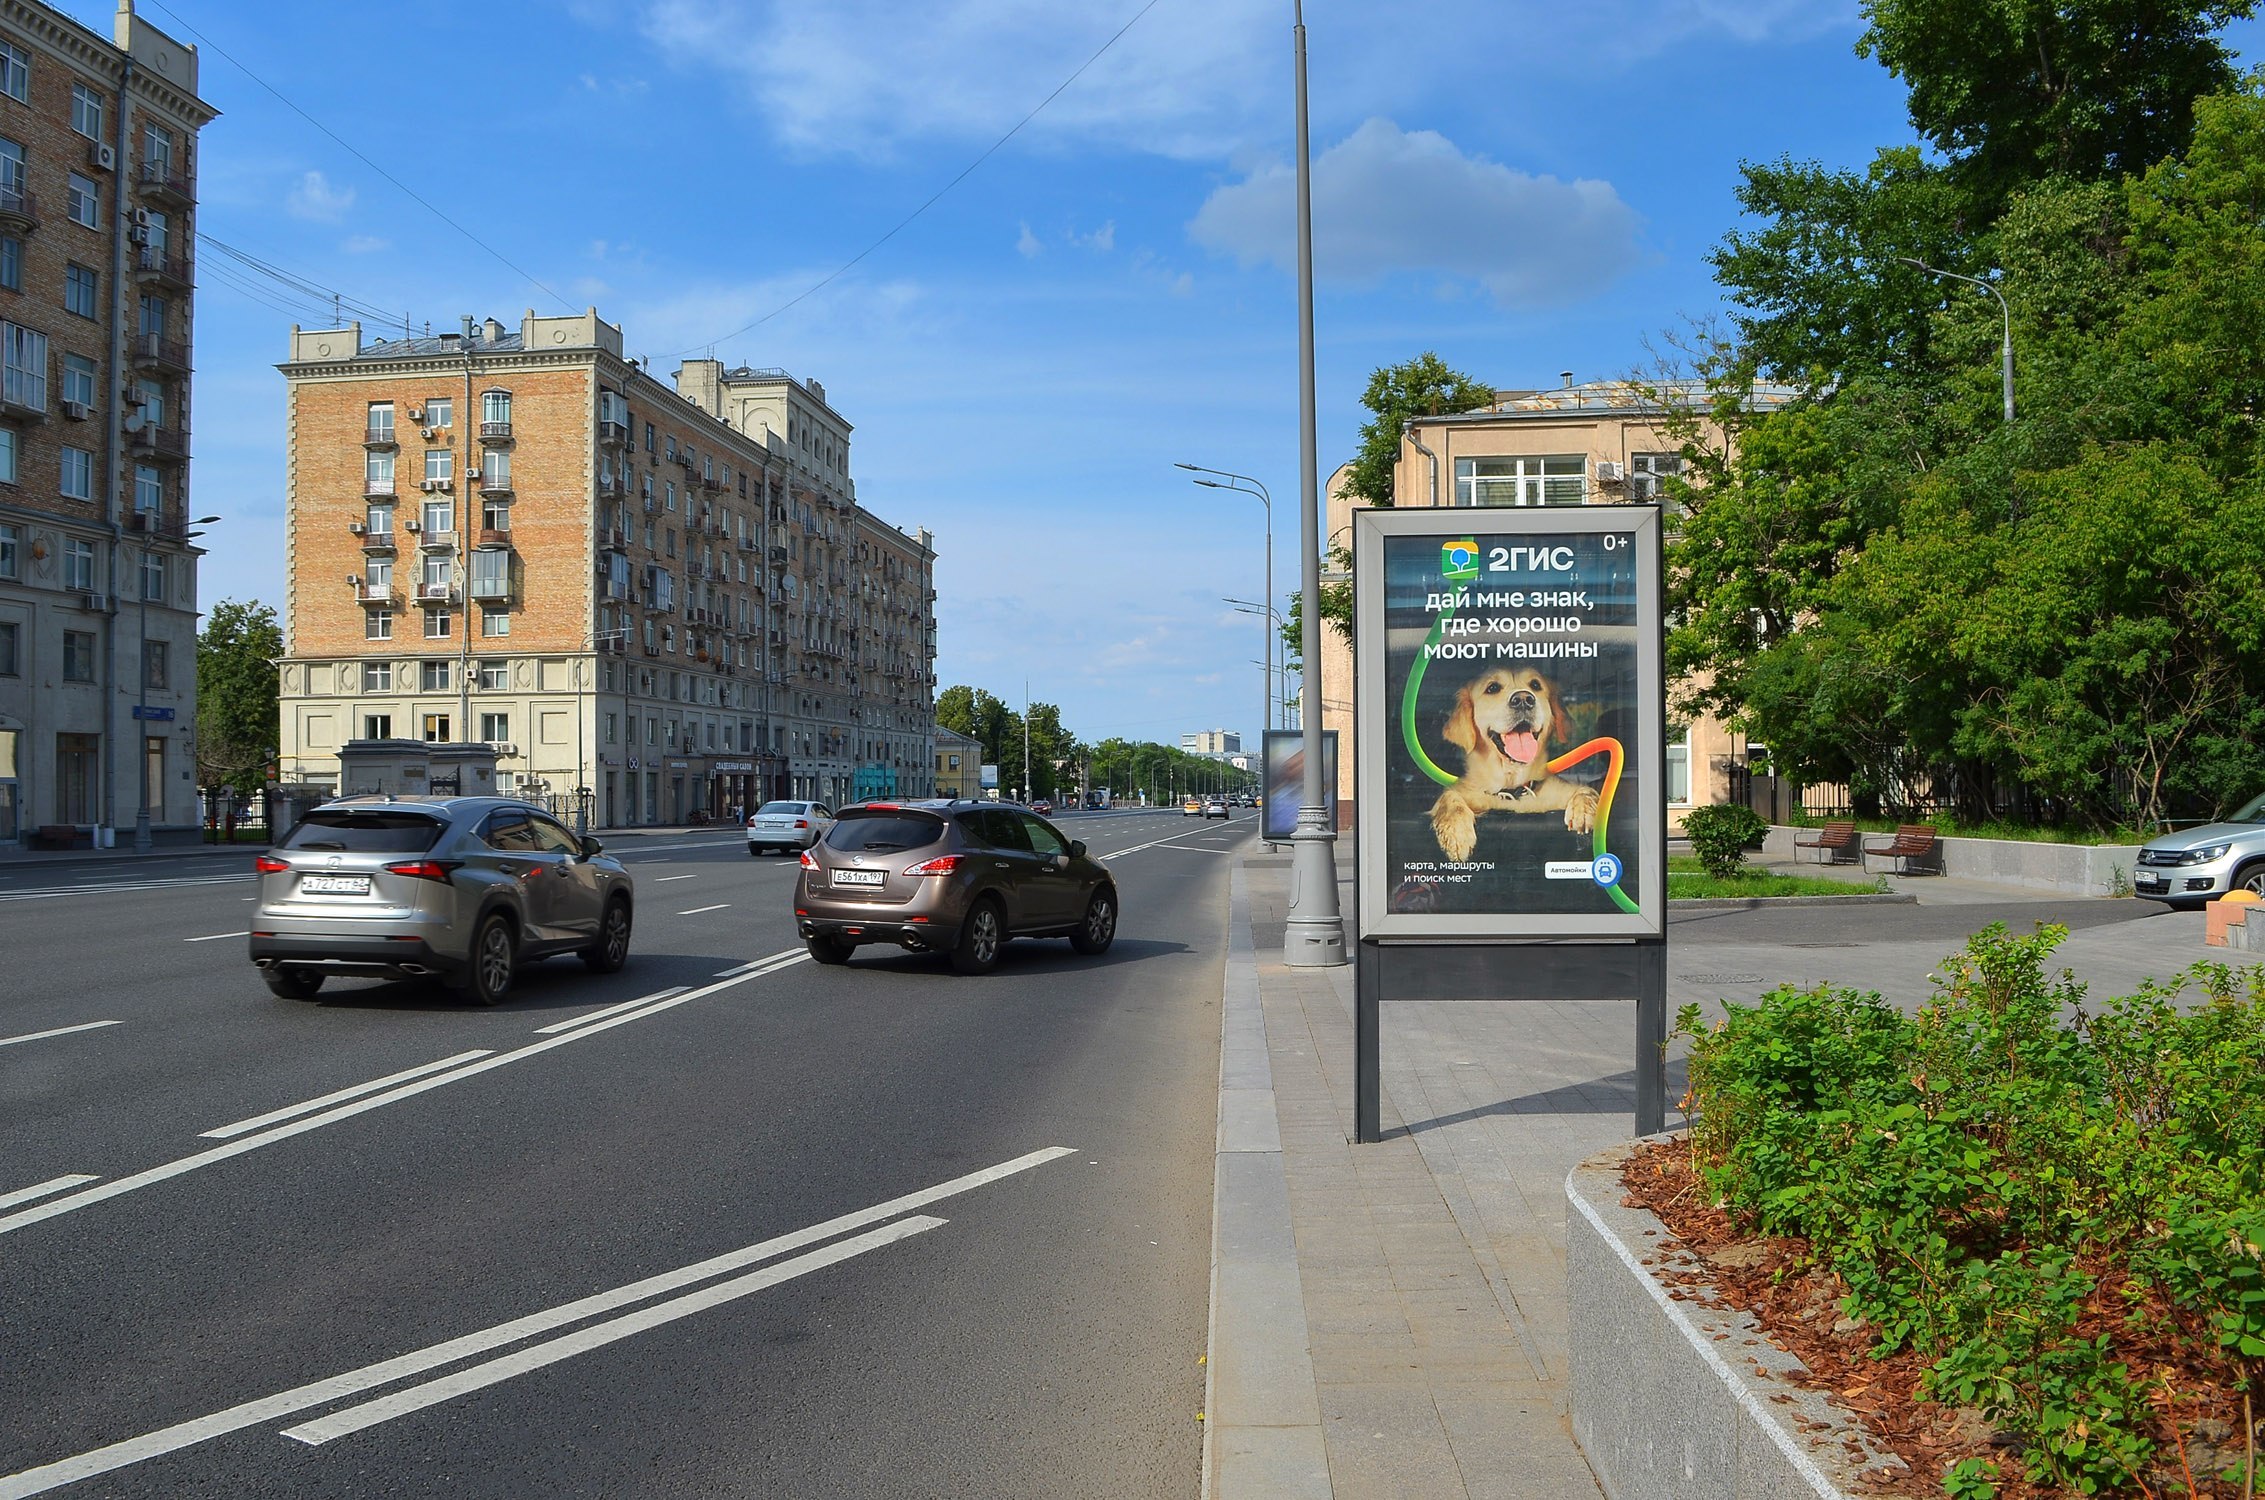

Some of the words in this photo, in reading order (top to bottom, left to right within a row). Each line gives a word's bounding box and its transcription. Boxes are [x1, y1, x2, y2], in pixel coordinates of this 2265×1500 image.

[1603, 534, 1628, 551] 0+
[1488, 546, 1575, 572] 2ГИС
[1425, 586, 1470, 612] дай
[1477, 592, 1525, 608] мне
[1530, 591, 1594, 611] знак,
[1440, 617, 1481, 637] где
[1486, 616, 1581, 637] хорошо
[1424, 643, 1490, 660] моют
[1496, 642, 1598, 659] машины
[1403, 861, 1437, 872] карта,
[1439, 861, 1495, 872] маршруты
[1550, 866, 1587, 875] Автомойки
[1404, 875, 1411, 883] и
[1413, 874, 1445, 883] поиск
[1446, 874, 1472, 883] мест
